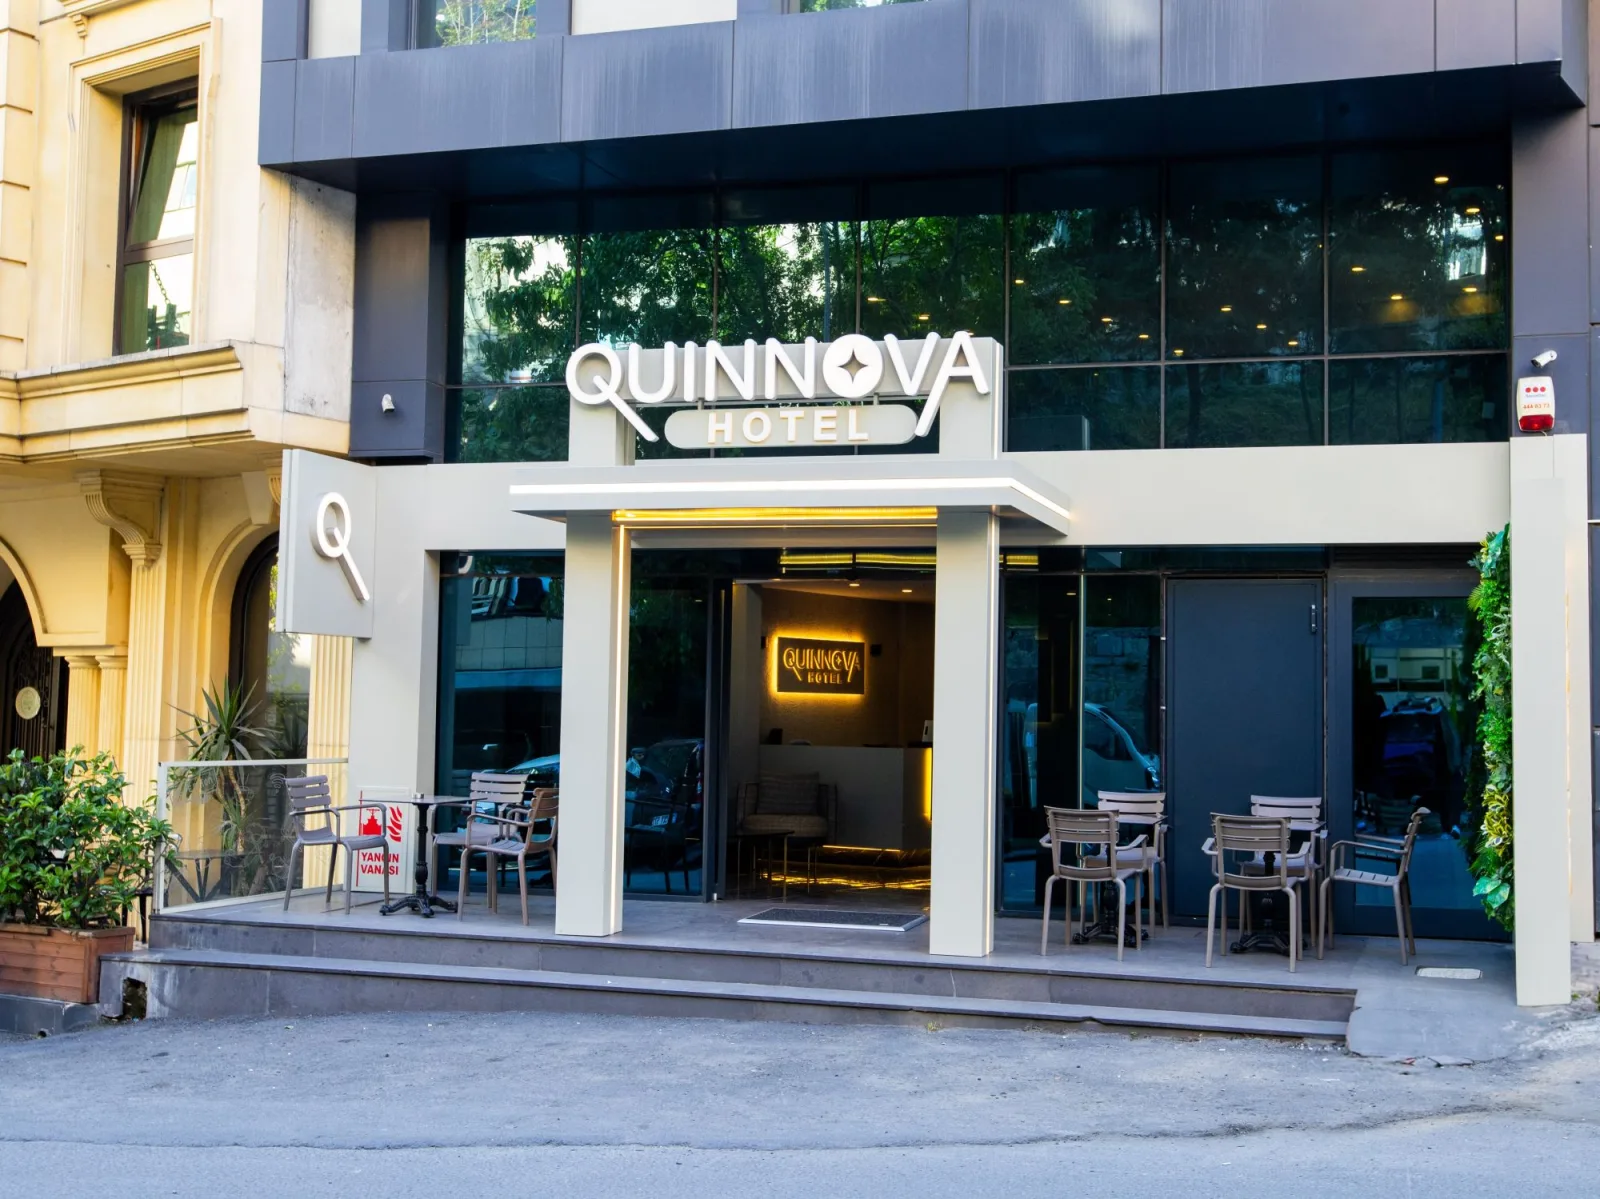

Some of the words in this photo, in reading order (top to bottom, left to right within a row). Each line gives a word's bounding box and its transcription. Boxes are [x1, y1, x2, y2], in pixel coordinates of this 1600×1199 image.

[565, 331, 992, 442] QUINNOVA
[707, 407, 869, 444] HOTEL
[315, 491, 370, 601] Q
[783, 647, 861, 682] QUINNOVA
[807, 671, 842, 684] HOTEL
